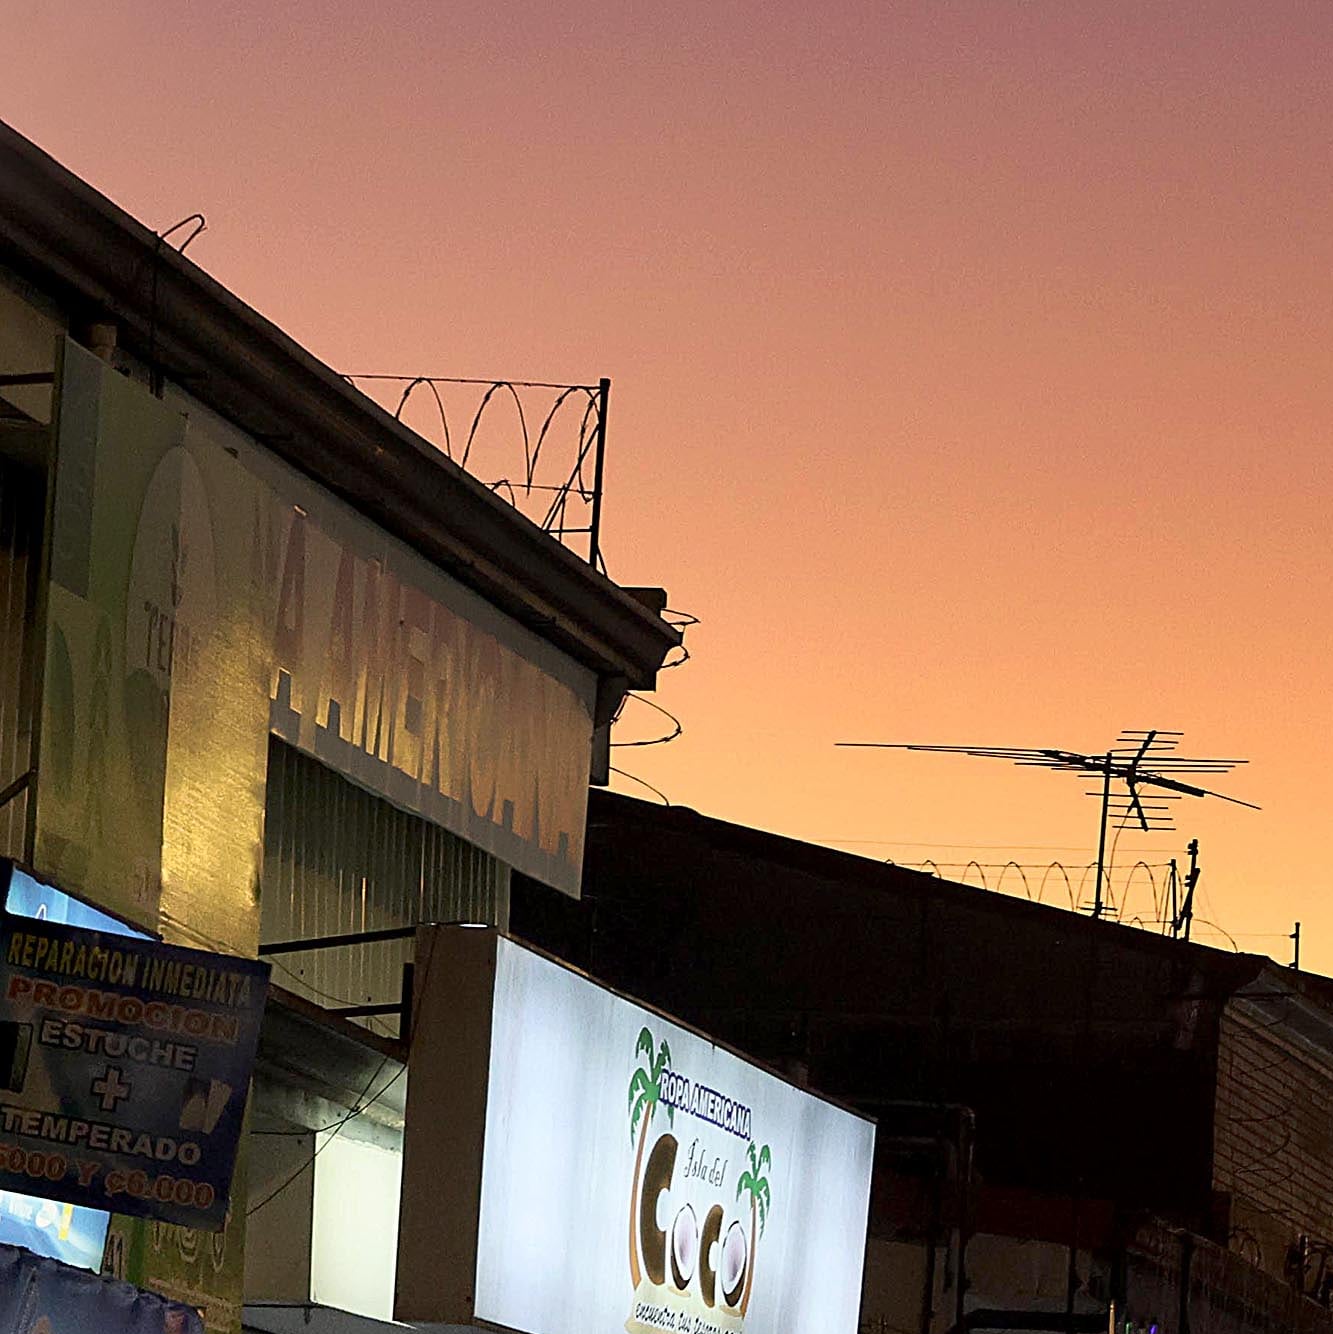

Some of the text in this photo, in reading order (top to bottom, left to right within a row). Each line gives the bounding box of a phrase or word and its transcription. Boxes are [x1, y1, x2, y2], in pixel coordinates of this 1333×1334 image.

[40, 1015, 200, 1072] ESTUCHE
[0, 1104, 203, 1167] TEMPERADO
[659, 1068, 752, 1142] ROPA AMERICANA
